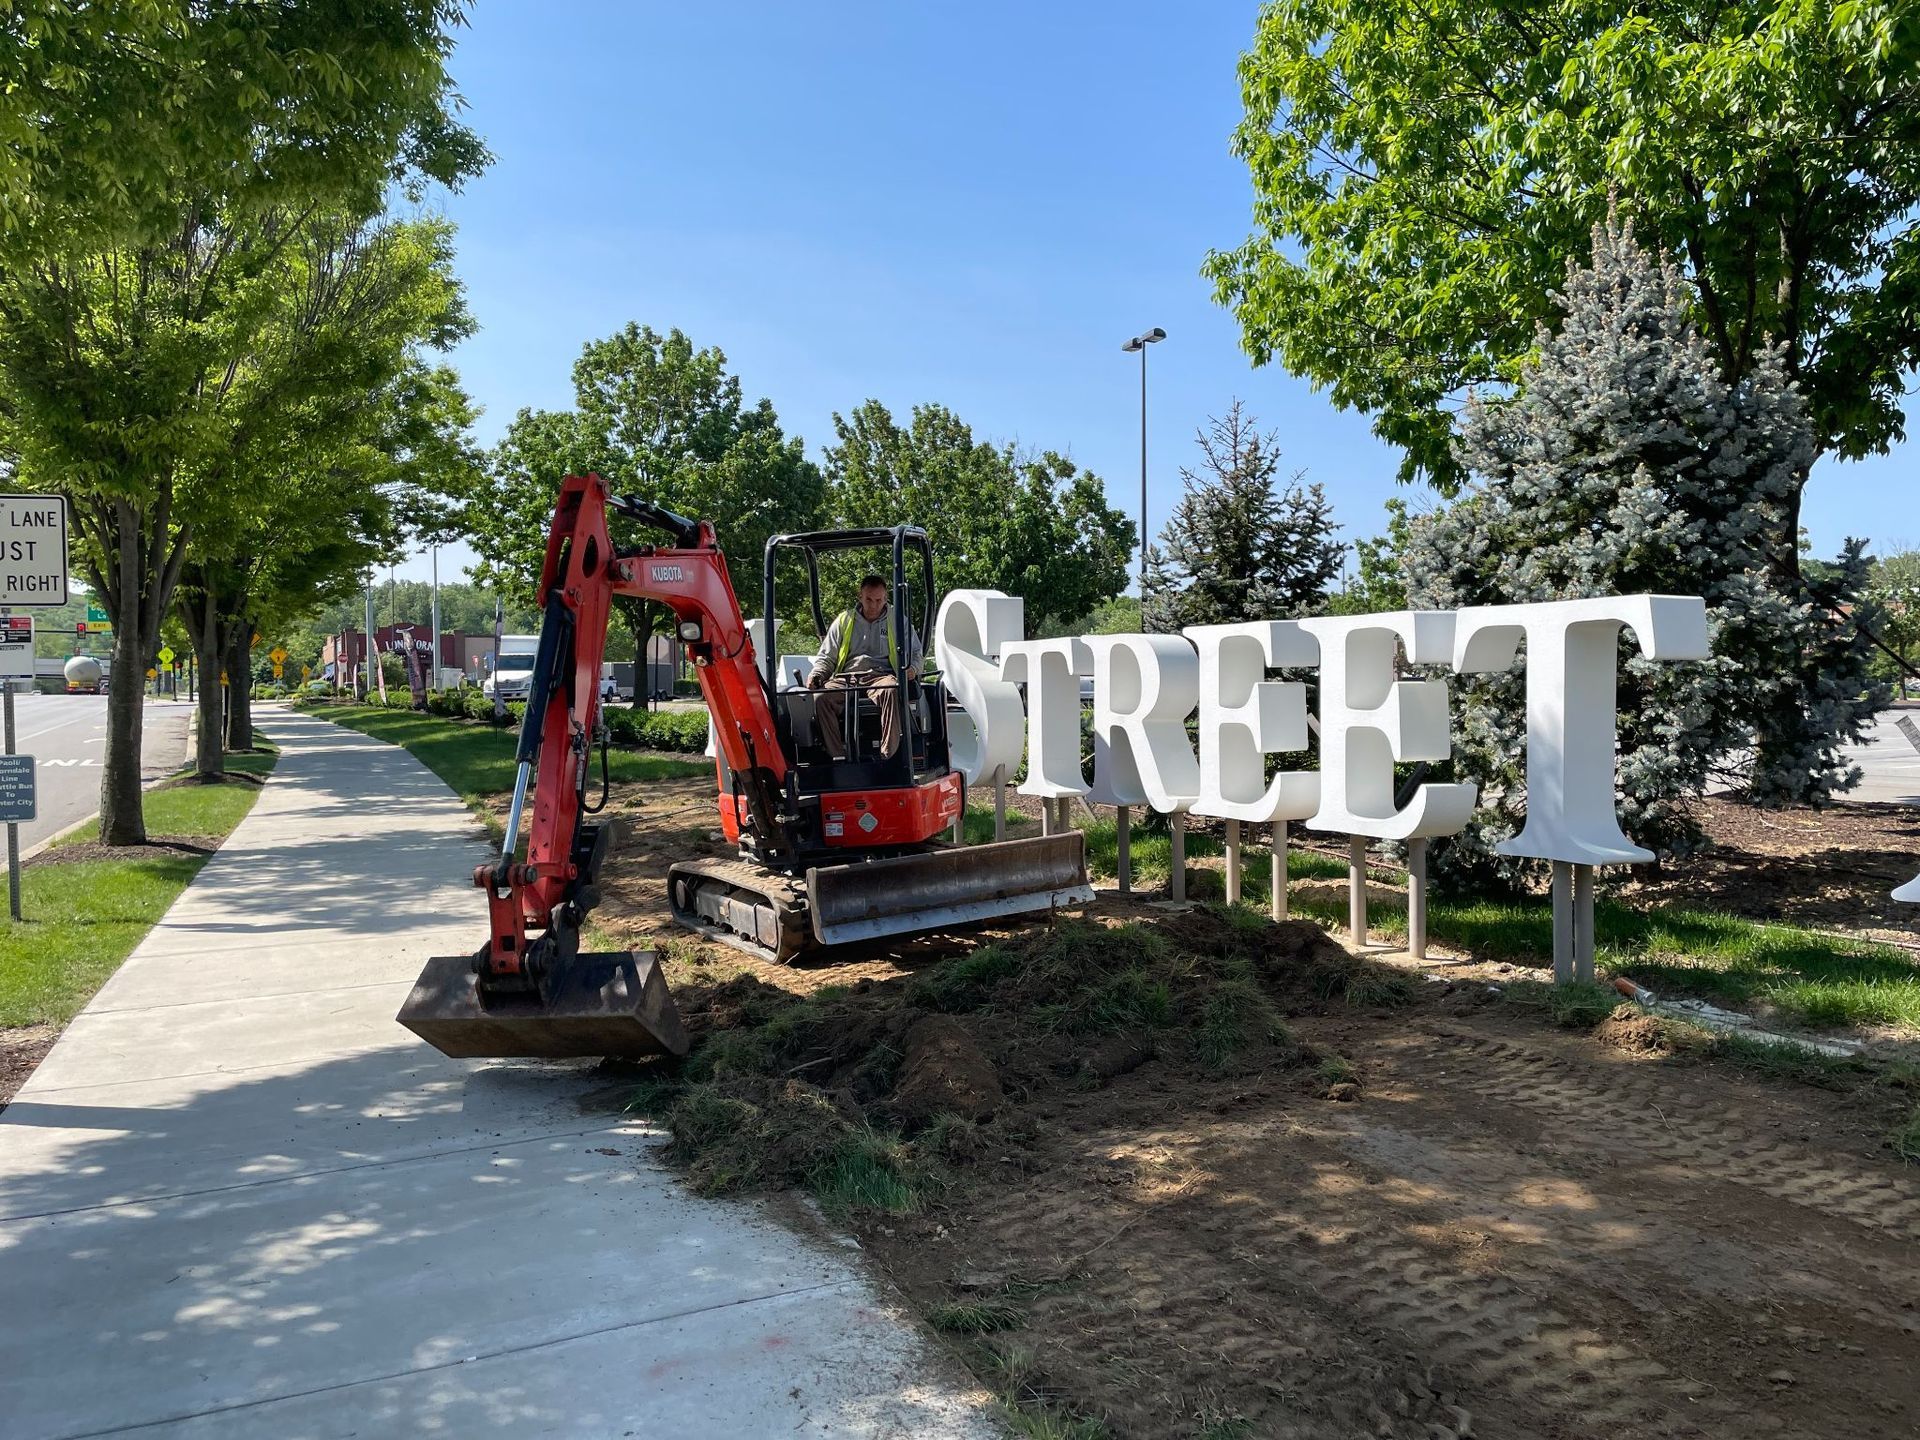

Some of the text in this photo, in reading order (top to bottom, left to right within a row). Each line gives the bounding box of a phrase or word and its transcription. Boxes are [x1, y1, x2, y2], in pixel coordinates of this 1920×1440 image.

[11, 511, 57, 527] LANE
[651, 566, 684, 582] KUBOTA
[7, 575, 60, 591] RIGHT
[934, 588, 1708, 865] STREET
